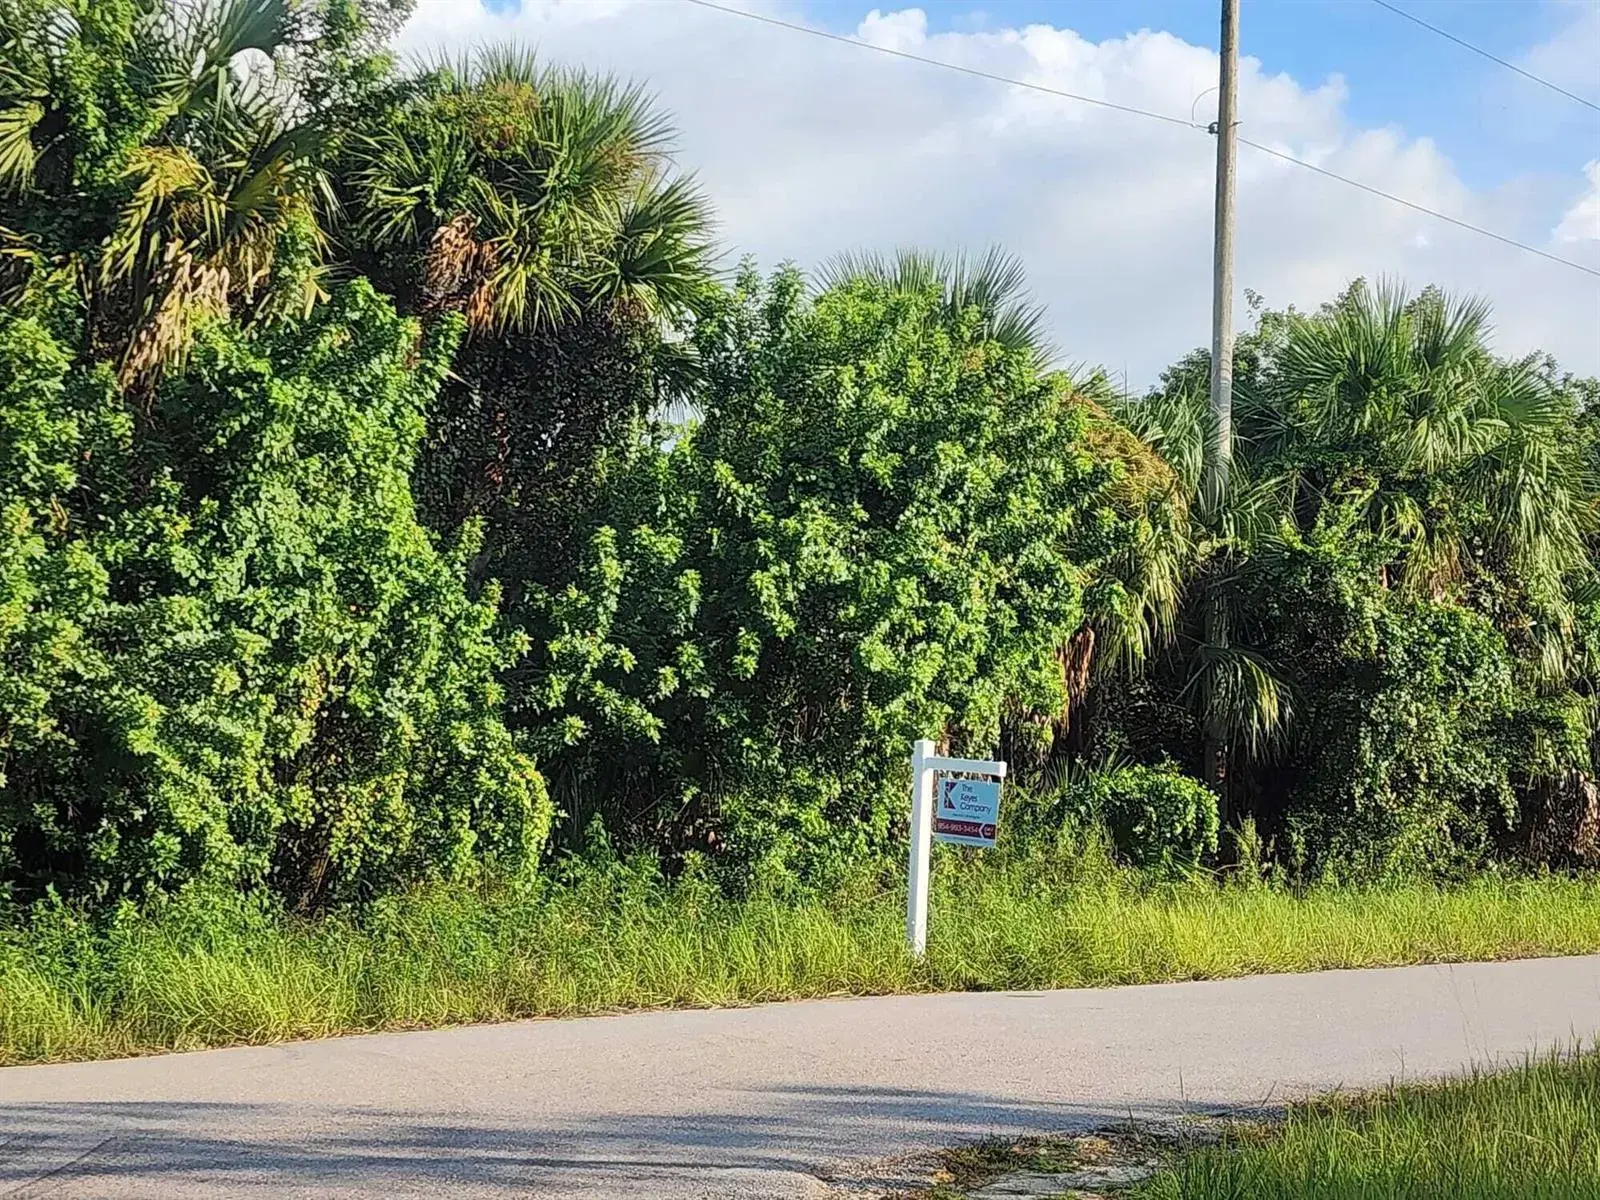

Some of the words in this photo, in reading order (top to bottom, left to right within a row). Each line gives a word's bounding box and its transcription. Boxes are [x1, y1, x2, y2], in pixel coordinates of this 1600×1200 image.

[962, 783, 973, 793] The
[960, 793, 978, 804] Keyes
[960, 802, 992, 815] Company
